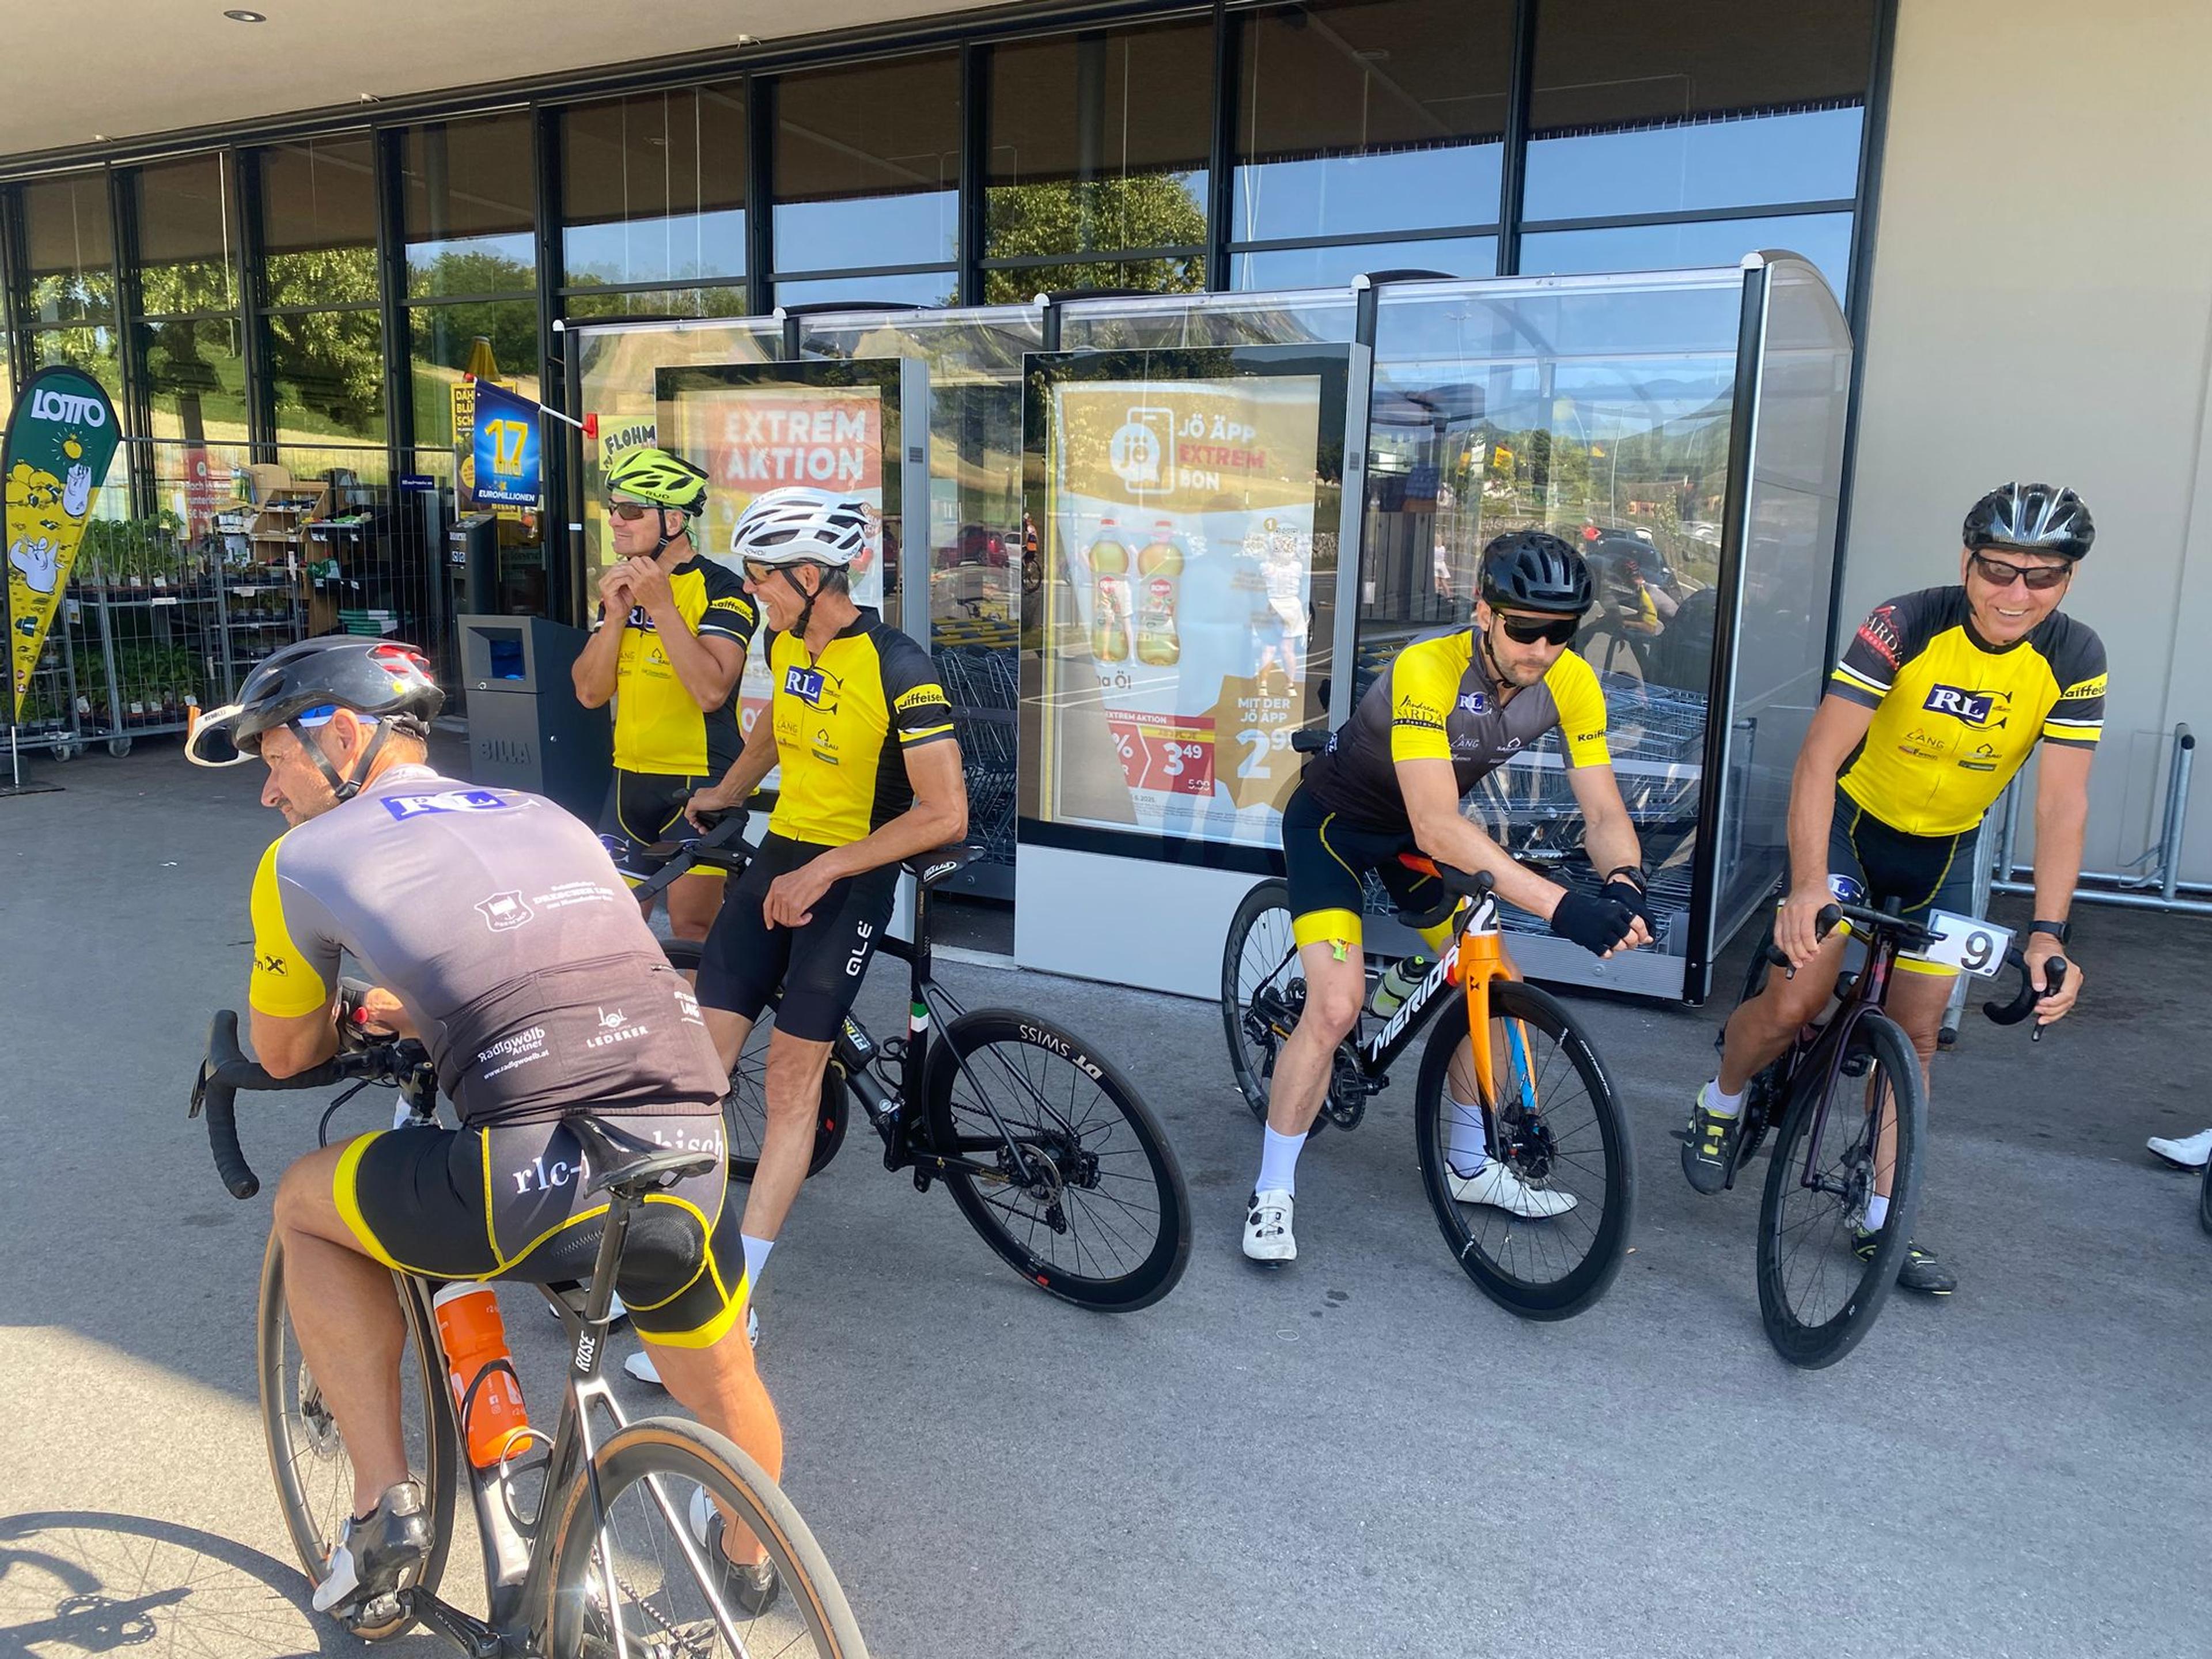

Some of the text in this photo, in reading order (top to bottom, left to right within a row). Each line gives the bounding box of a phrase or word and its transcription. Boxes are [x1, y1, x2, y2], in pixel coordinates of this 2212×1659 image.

[31, 388, 105, 427] LOTTO
[456, 391, 474, 401] DAH
[605, 425, 656, 455] FLOHM
[727, 410, 866, 443] EXTREM
[1178, 413, 1257, 442] JÖ ÄPP
[484, 418, 528, 467] 17
[1178, 444, 1266, 469] EXTREM
[727, 447, 864, 480] AKTION
[1179, 469, 1220, 491] BON
[478, 489, 535, 502] EUROMILLIONEN
[1238, 698, 1291, 709] MIT DER
[1240, 708, 1288, 722] JÖ ÄPP
[480, 738, 531, 766] BILLA
[1372, 944, 1459, 1063] MERIDA
[512, 1039, 543, 1055] Artner
[586, 1026, 649, 1048] LEDERER
[1019, 1024, 1103, 1080] DT SWISS
[576, 1330, 596, 1373] ROSE
